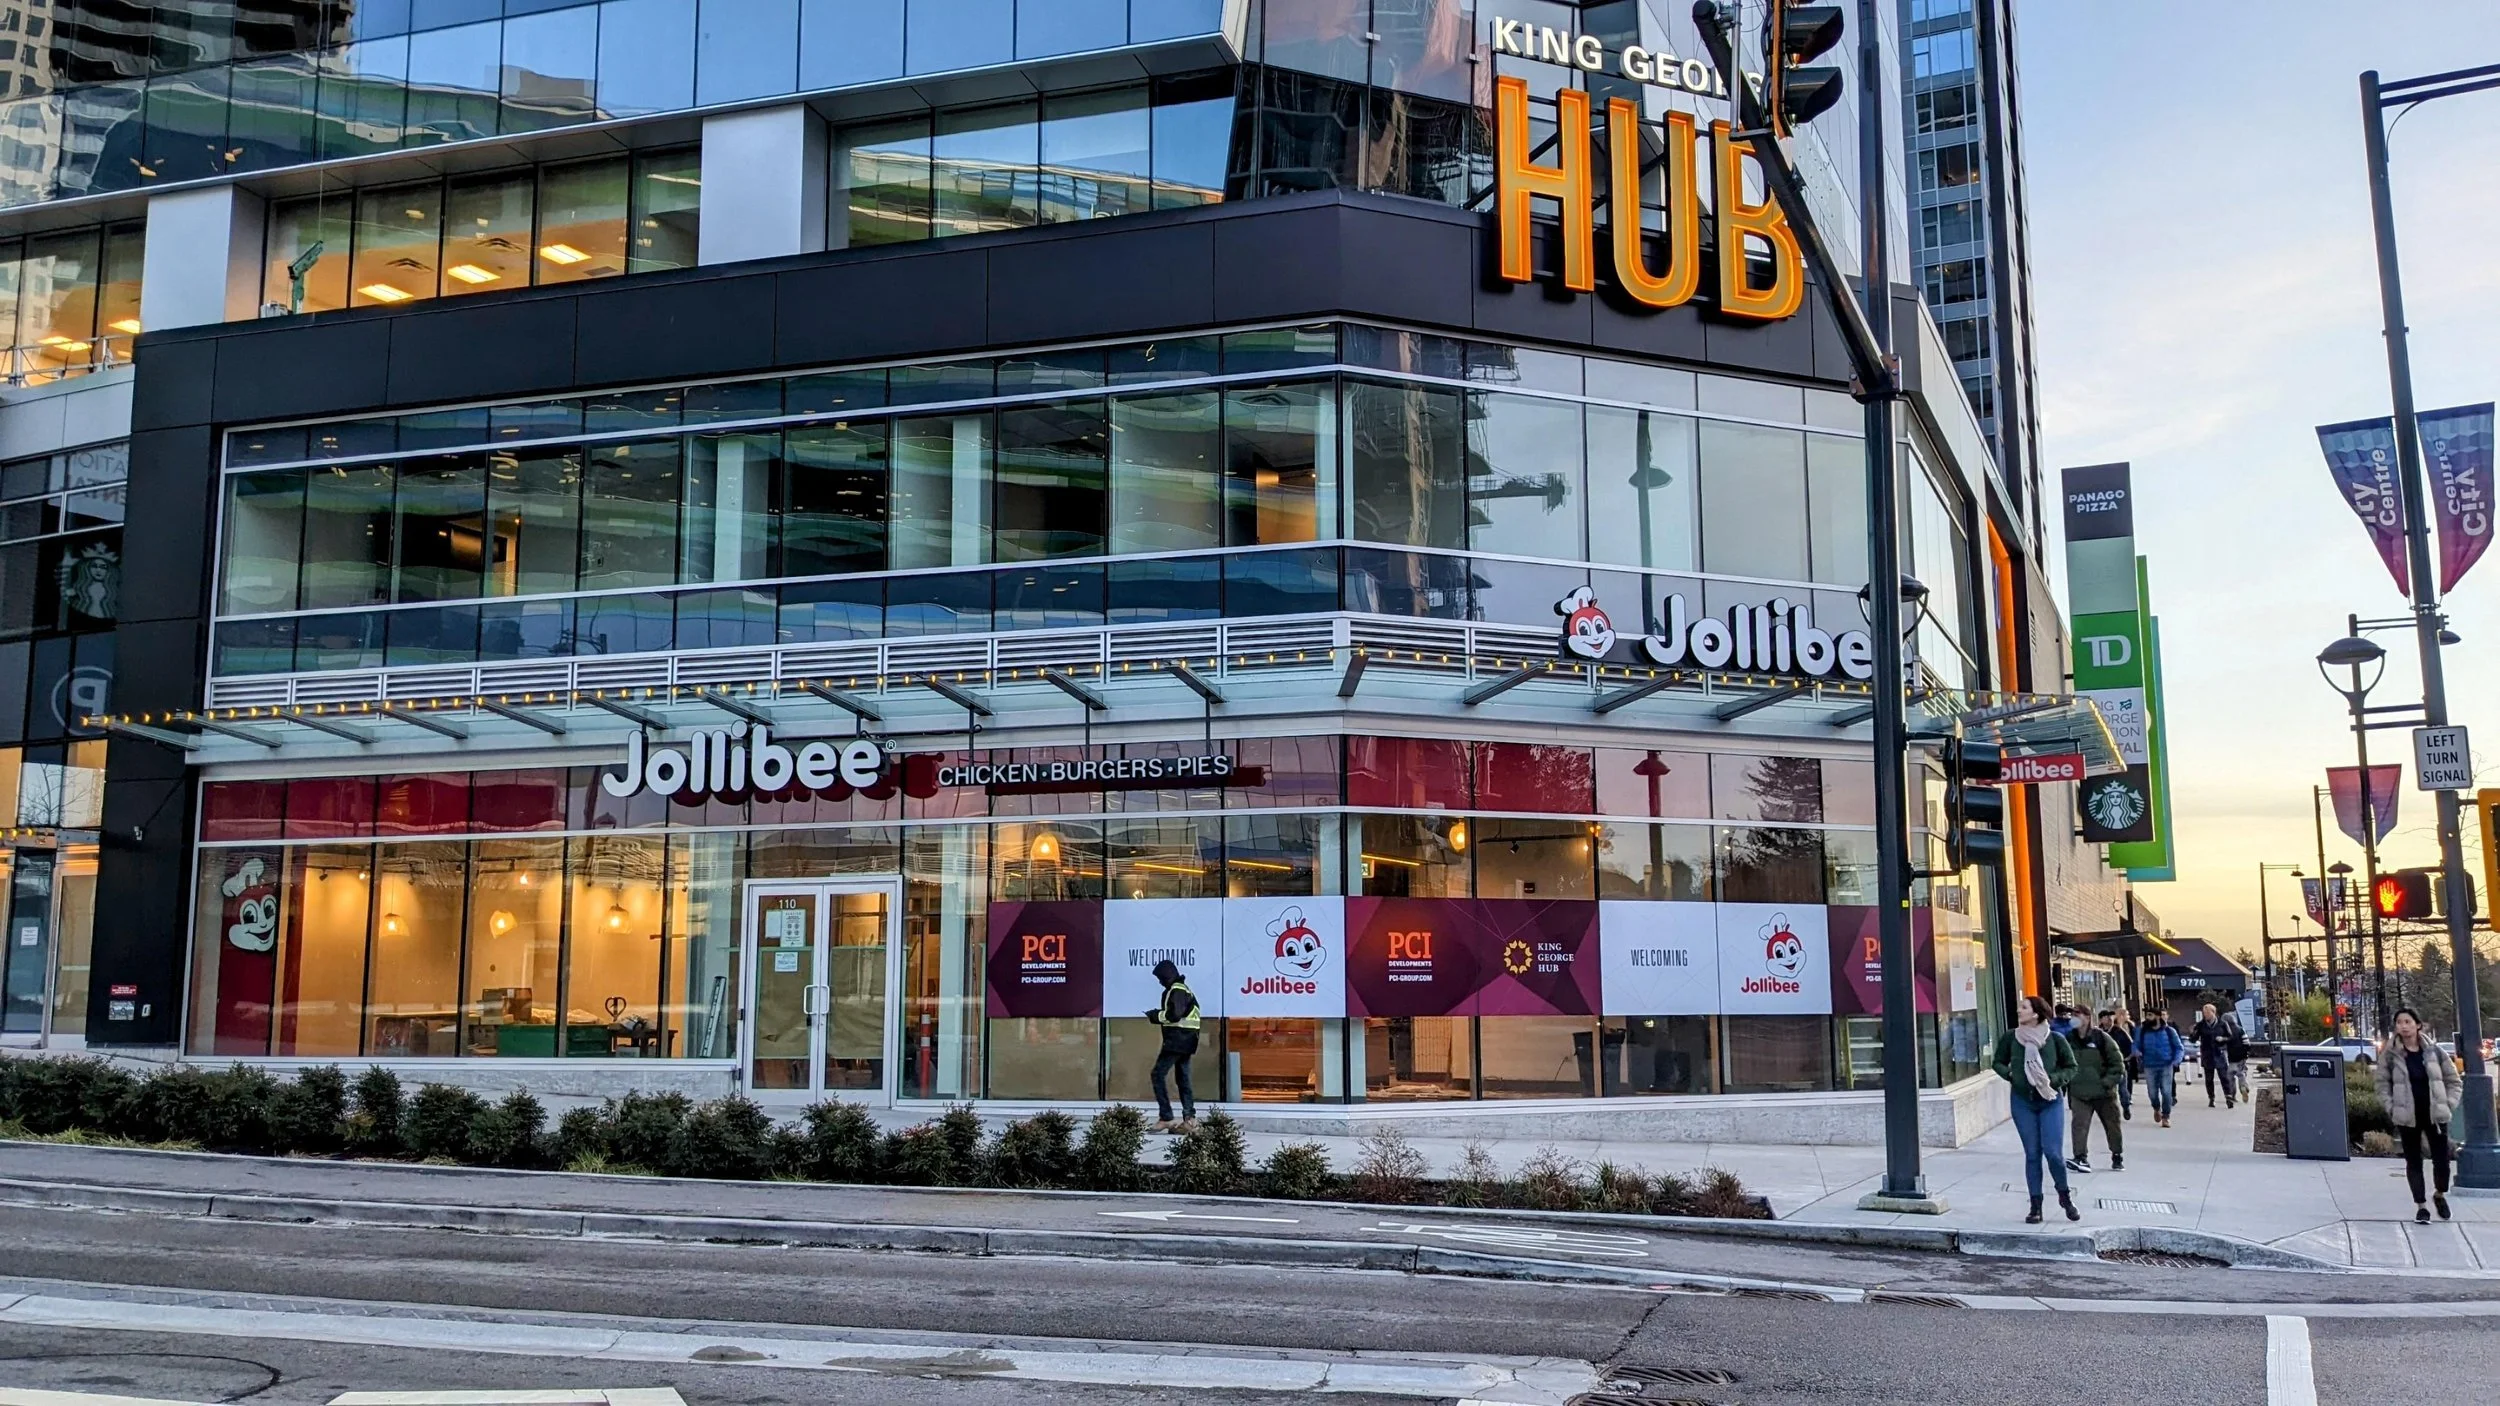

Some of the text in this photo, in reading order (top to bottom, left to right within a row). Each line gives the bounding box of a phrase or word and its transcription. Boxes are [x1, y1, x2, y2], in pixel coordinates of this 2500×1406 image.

[1494, 16, 1764, 97] KING GEO
[1496, 75, 1803, 320] HUB
[2069, 489, 2125, 503] PANAGO
[2372, 449, 2397, 526] Centre
[2077, 501, 2118, 513] PIZZA
[2081, 634, 2131, 667] TD
[2426, 734, 2456, 748] LEFT
[602, 719, 884, 798] Jollibee
[2426, 752, 2459, 765] TURN
[938, 755, 1229, 786] CHICKEN BURGERS PIES
[2001, 760, 2074, 780] ollibee
[2423, 769, 2467, 783] SIGNAL
[779, 899, 796, 909] 110
[1022, 935, 1066, 961] PCI
[1388, 932, 1432, 958] PCI
[1537, 942, 1562, 951] KING
[1128, 948, 1195, 967] WELCOMING
[1537, 953, 1575, 962] GEORGE
[1630, 949, 1688, 967] WELCOMING
[1538, 964, 1559, 973] HUB
[1240, 976, 1316, 995] Jollibee
[1741, 976, 1800, 994] Jollibee
[2180, 978, 2206, 987] 9770
